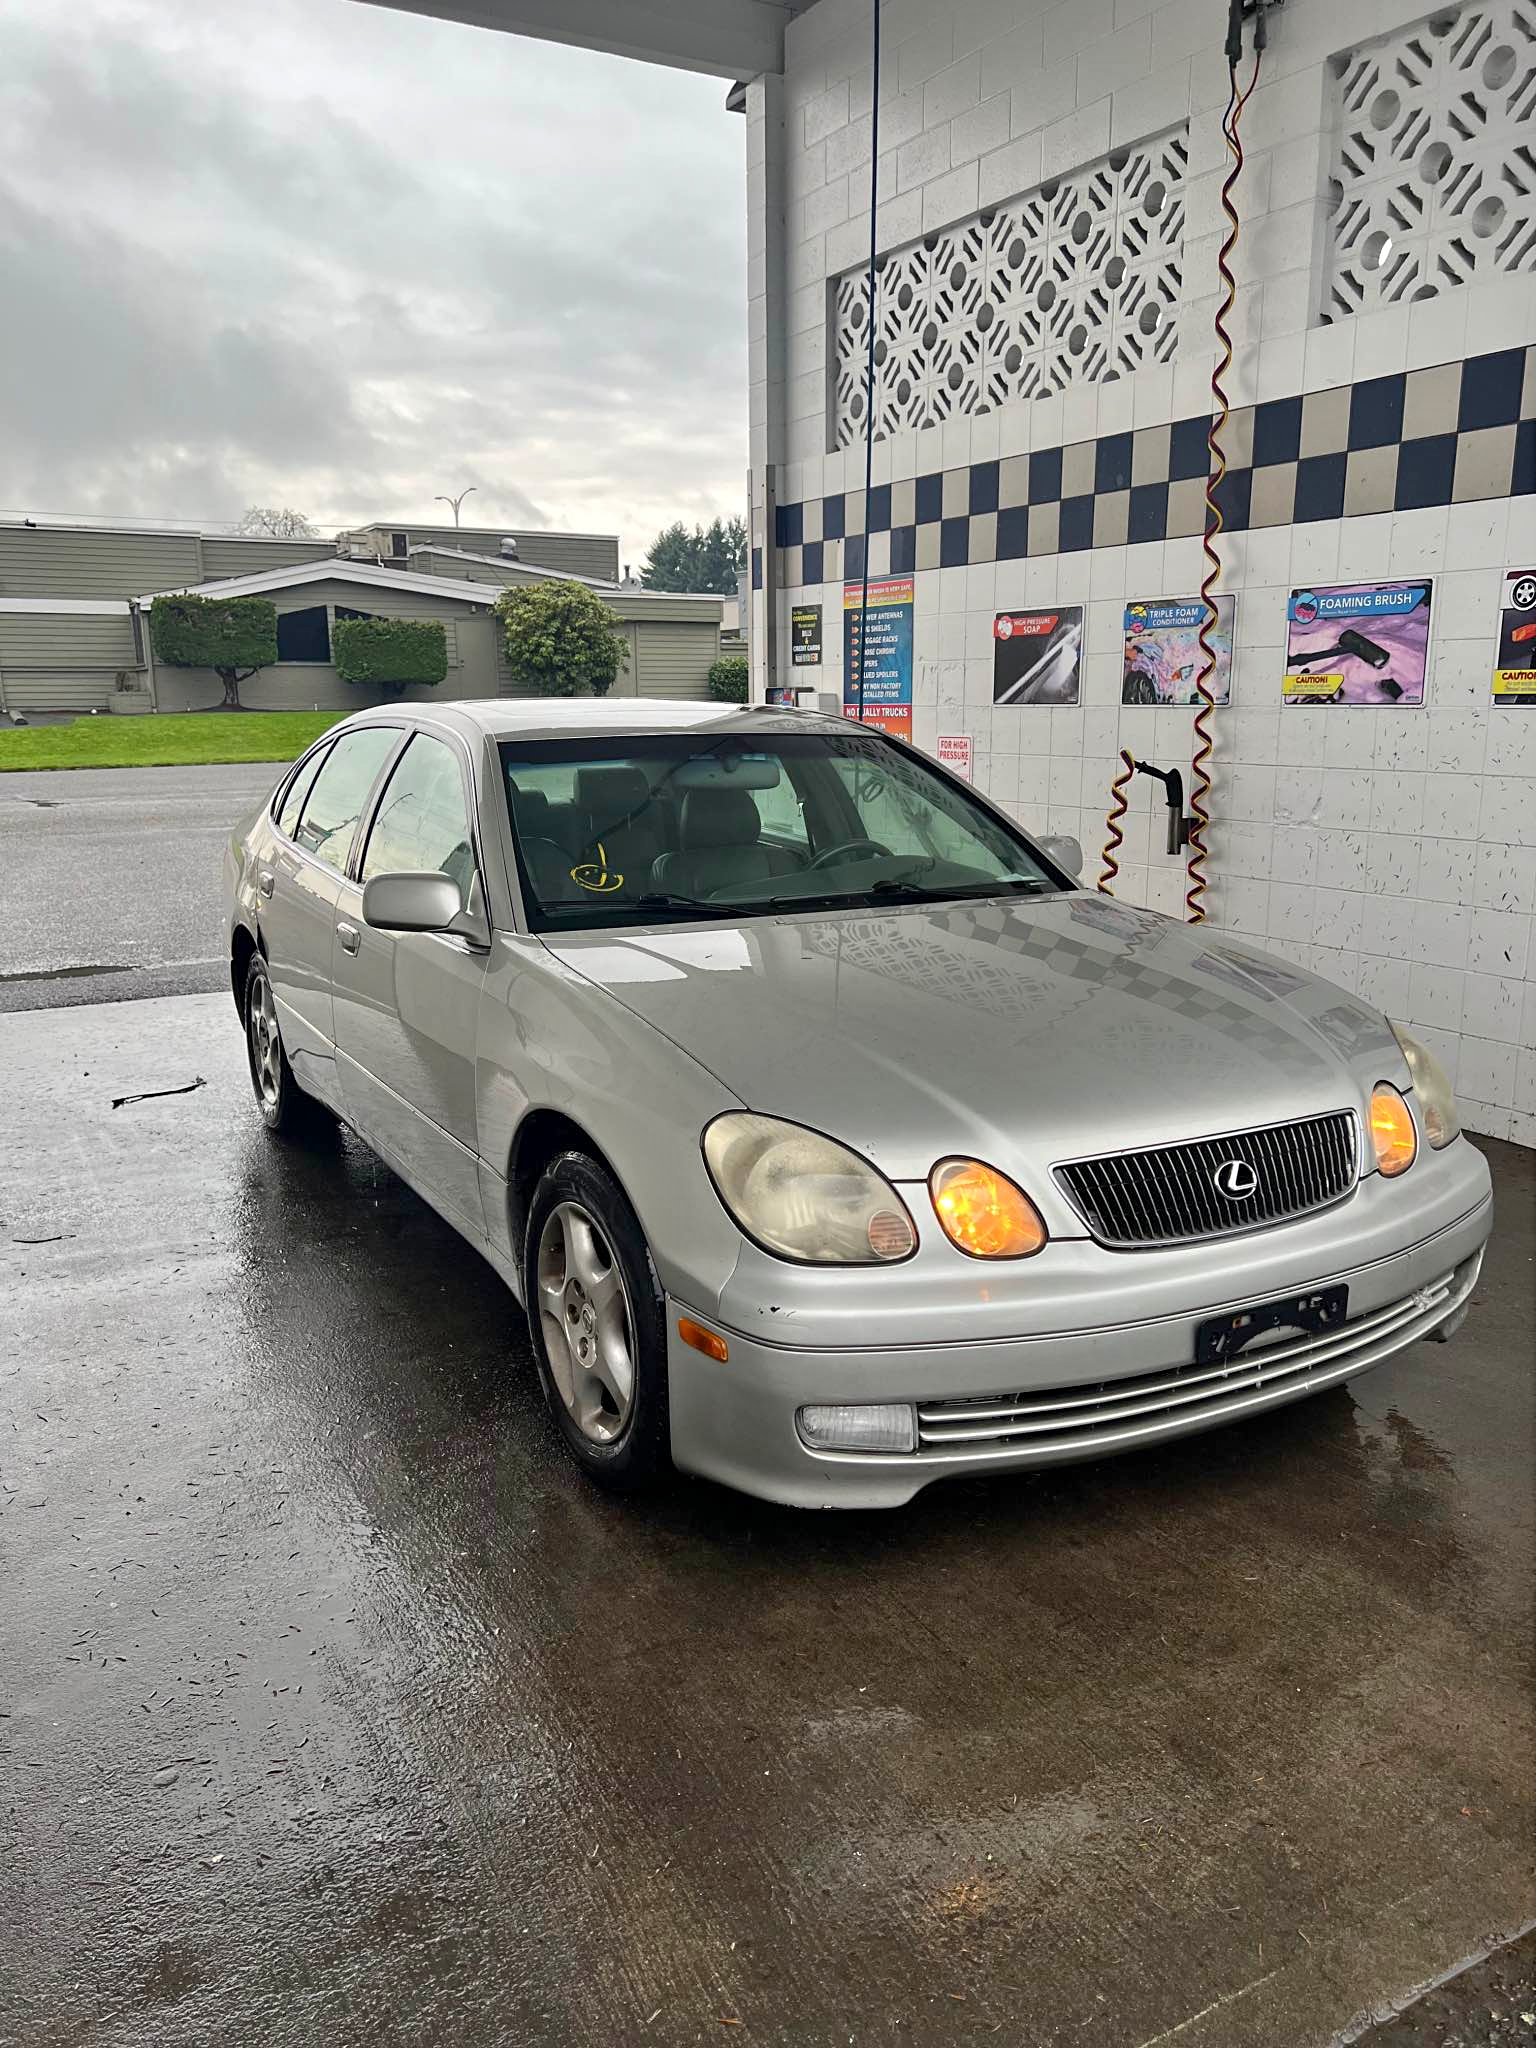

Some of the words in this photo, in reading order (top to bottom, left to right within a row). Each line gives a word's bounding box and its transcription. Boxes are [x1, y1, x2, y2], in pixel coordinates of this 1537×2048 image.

[1320, 596, 1372, 609] FOAMING
[1375, 593, 1412, 606] BRUSH
[878, 611, 903, 620] ANTENNAS
[1150, 609, 1174, 618] TRIPLE
[1175, 607, 1199, 616] FOAM
[1027, 617, 1051, 625] PRESSURE
[1152, 617, 1194, 626] CONDITIONER
[870, 624, 891, 632] SHIELDS
[1023, 625, 1041, 634] SOAP
[865, 636, 882, 644] GGAGE
[863, 671, 876, 679] LUED
[876, 670, 898, 678] SPOILERS
[880, 682, 902, 690] FACTORY
[846, 707, 856, 717] NO
[882, 706, 908, 717] TRUCKS
[940, 740, 952, 749] FOR
[953, 740, 968, 750] HIGH
[940, 751, 969, 760] PRESSURE
